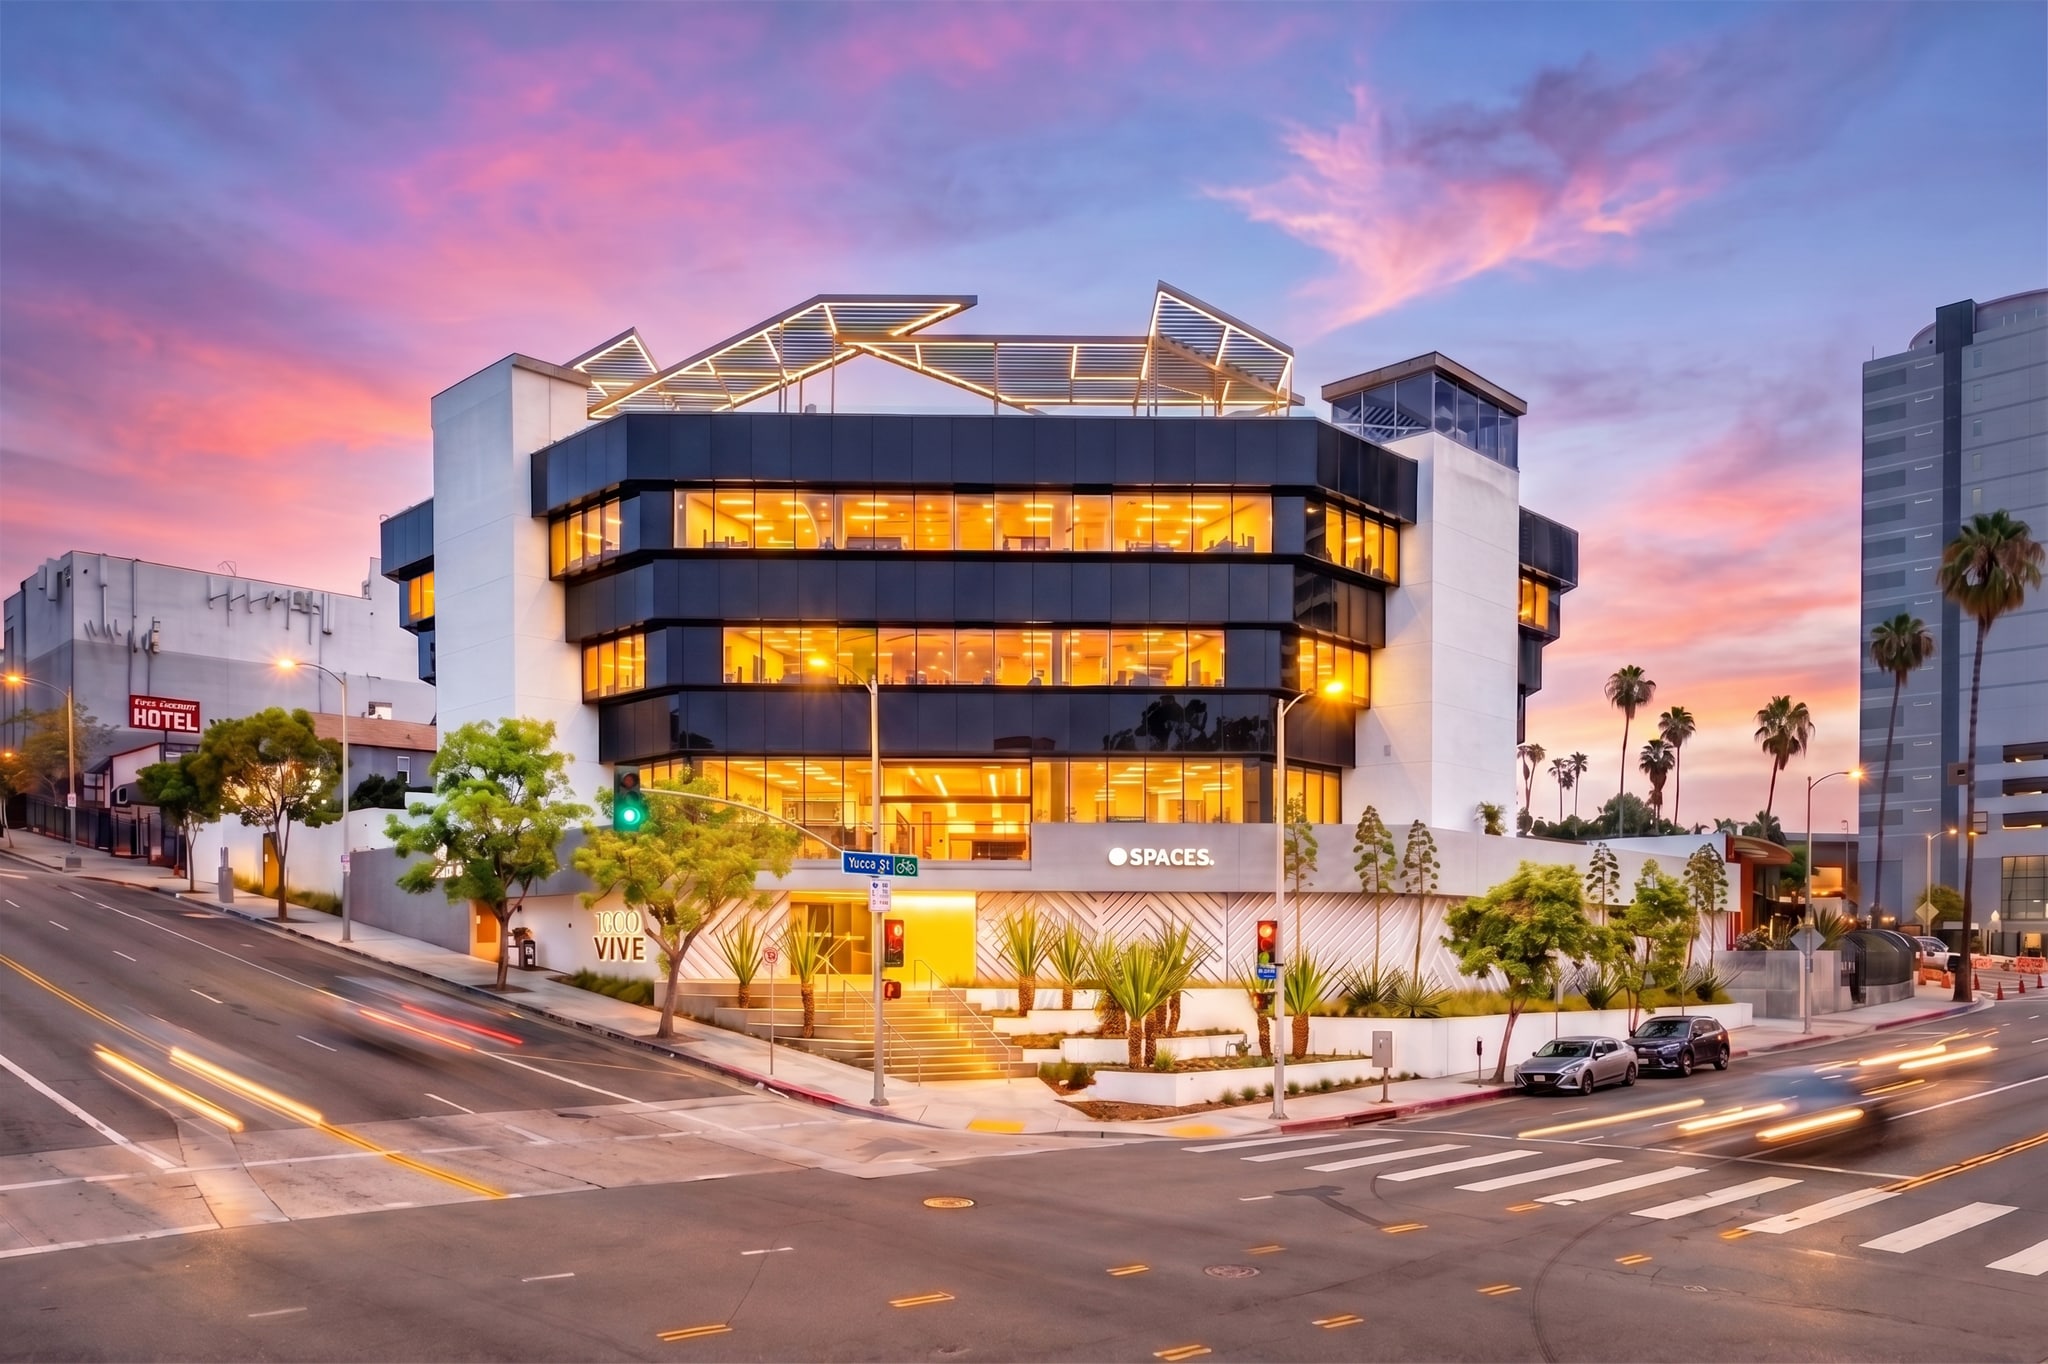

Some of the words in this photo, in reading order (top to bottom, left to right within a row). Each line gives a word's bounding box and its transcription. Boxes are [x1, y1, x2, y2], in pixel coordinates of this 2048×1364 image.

[133, 708, 198, 731] HOTEL
[848, 857, 876, 869] Yucca
[879, 859, 890, 871] St
[1129, 848, 1215, 866] SPACES.
[593, 937, 645, 960] VIVE
